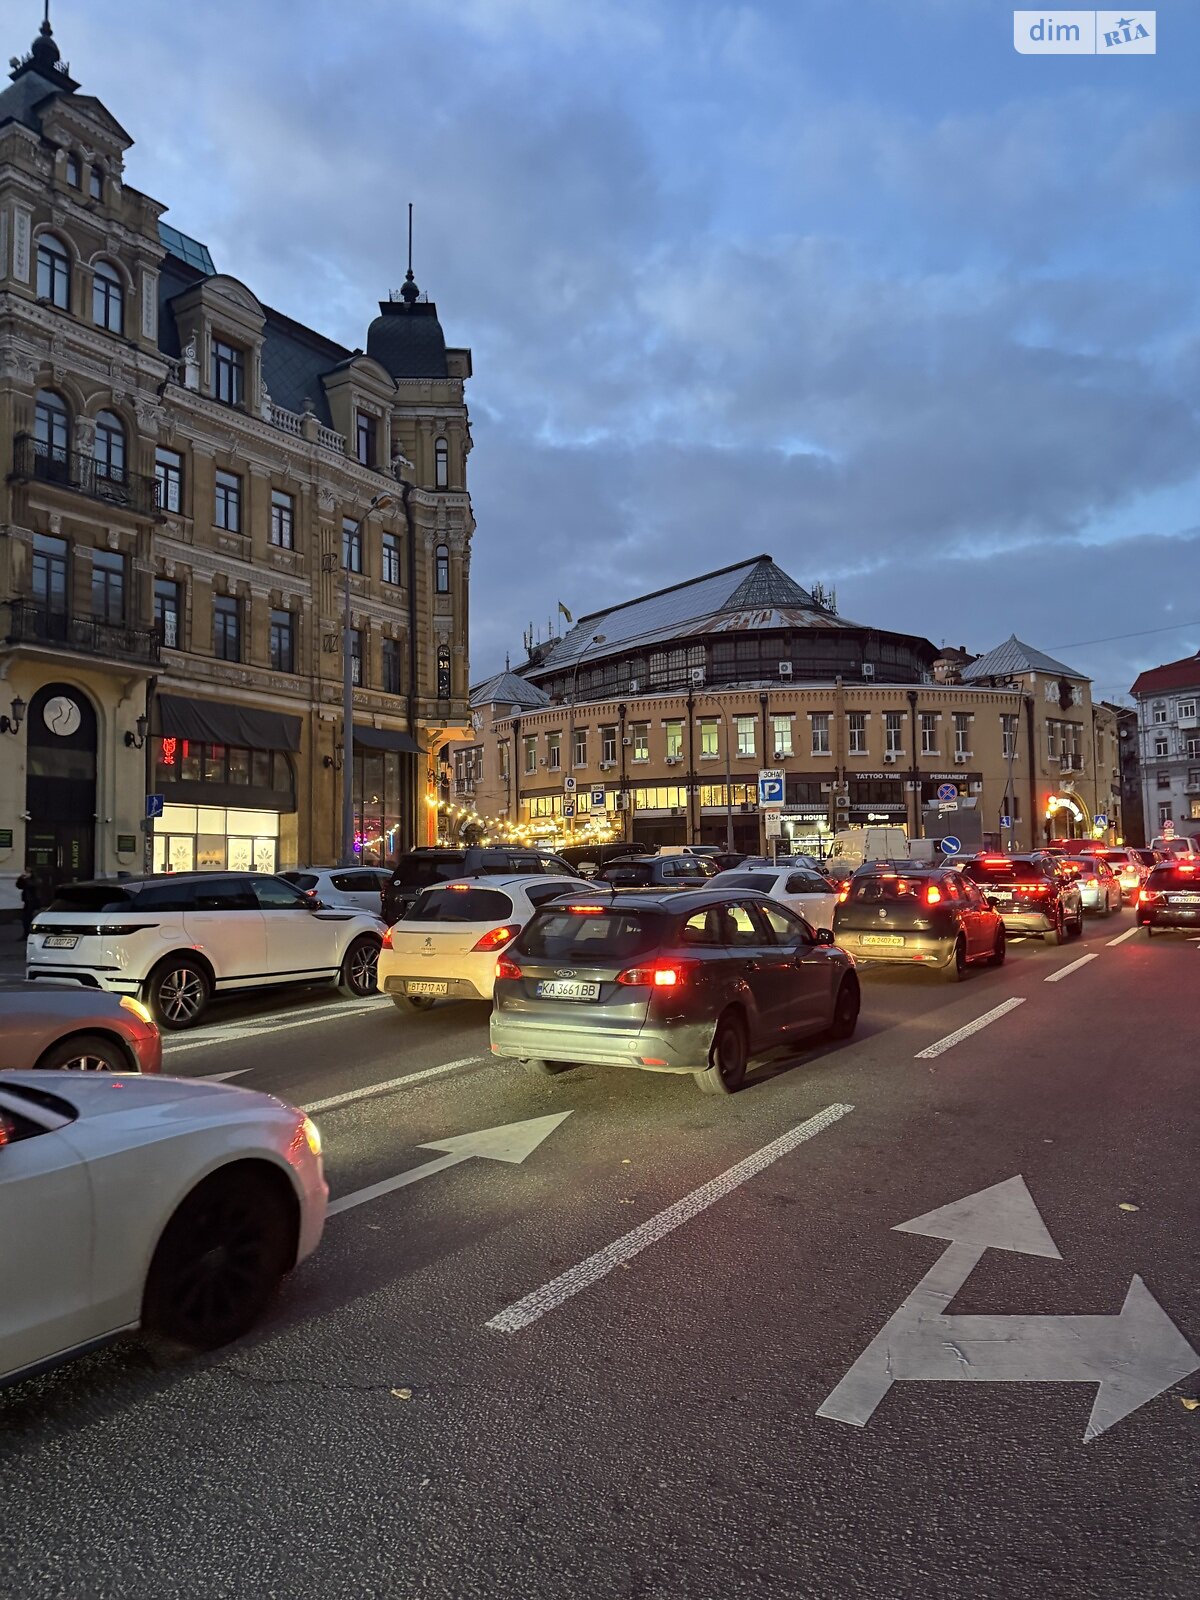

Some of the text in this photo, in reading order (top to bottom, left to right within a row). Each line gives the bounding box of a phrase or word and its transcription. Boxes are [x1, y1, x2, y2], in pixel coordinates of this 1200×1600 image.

[436, 984, 446, 992] AX
[542, 983, 596, 996] KA 3661 BB
